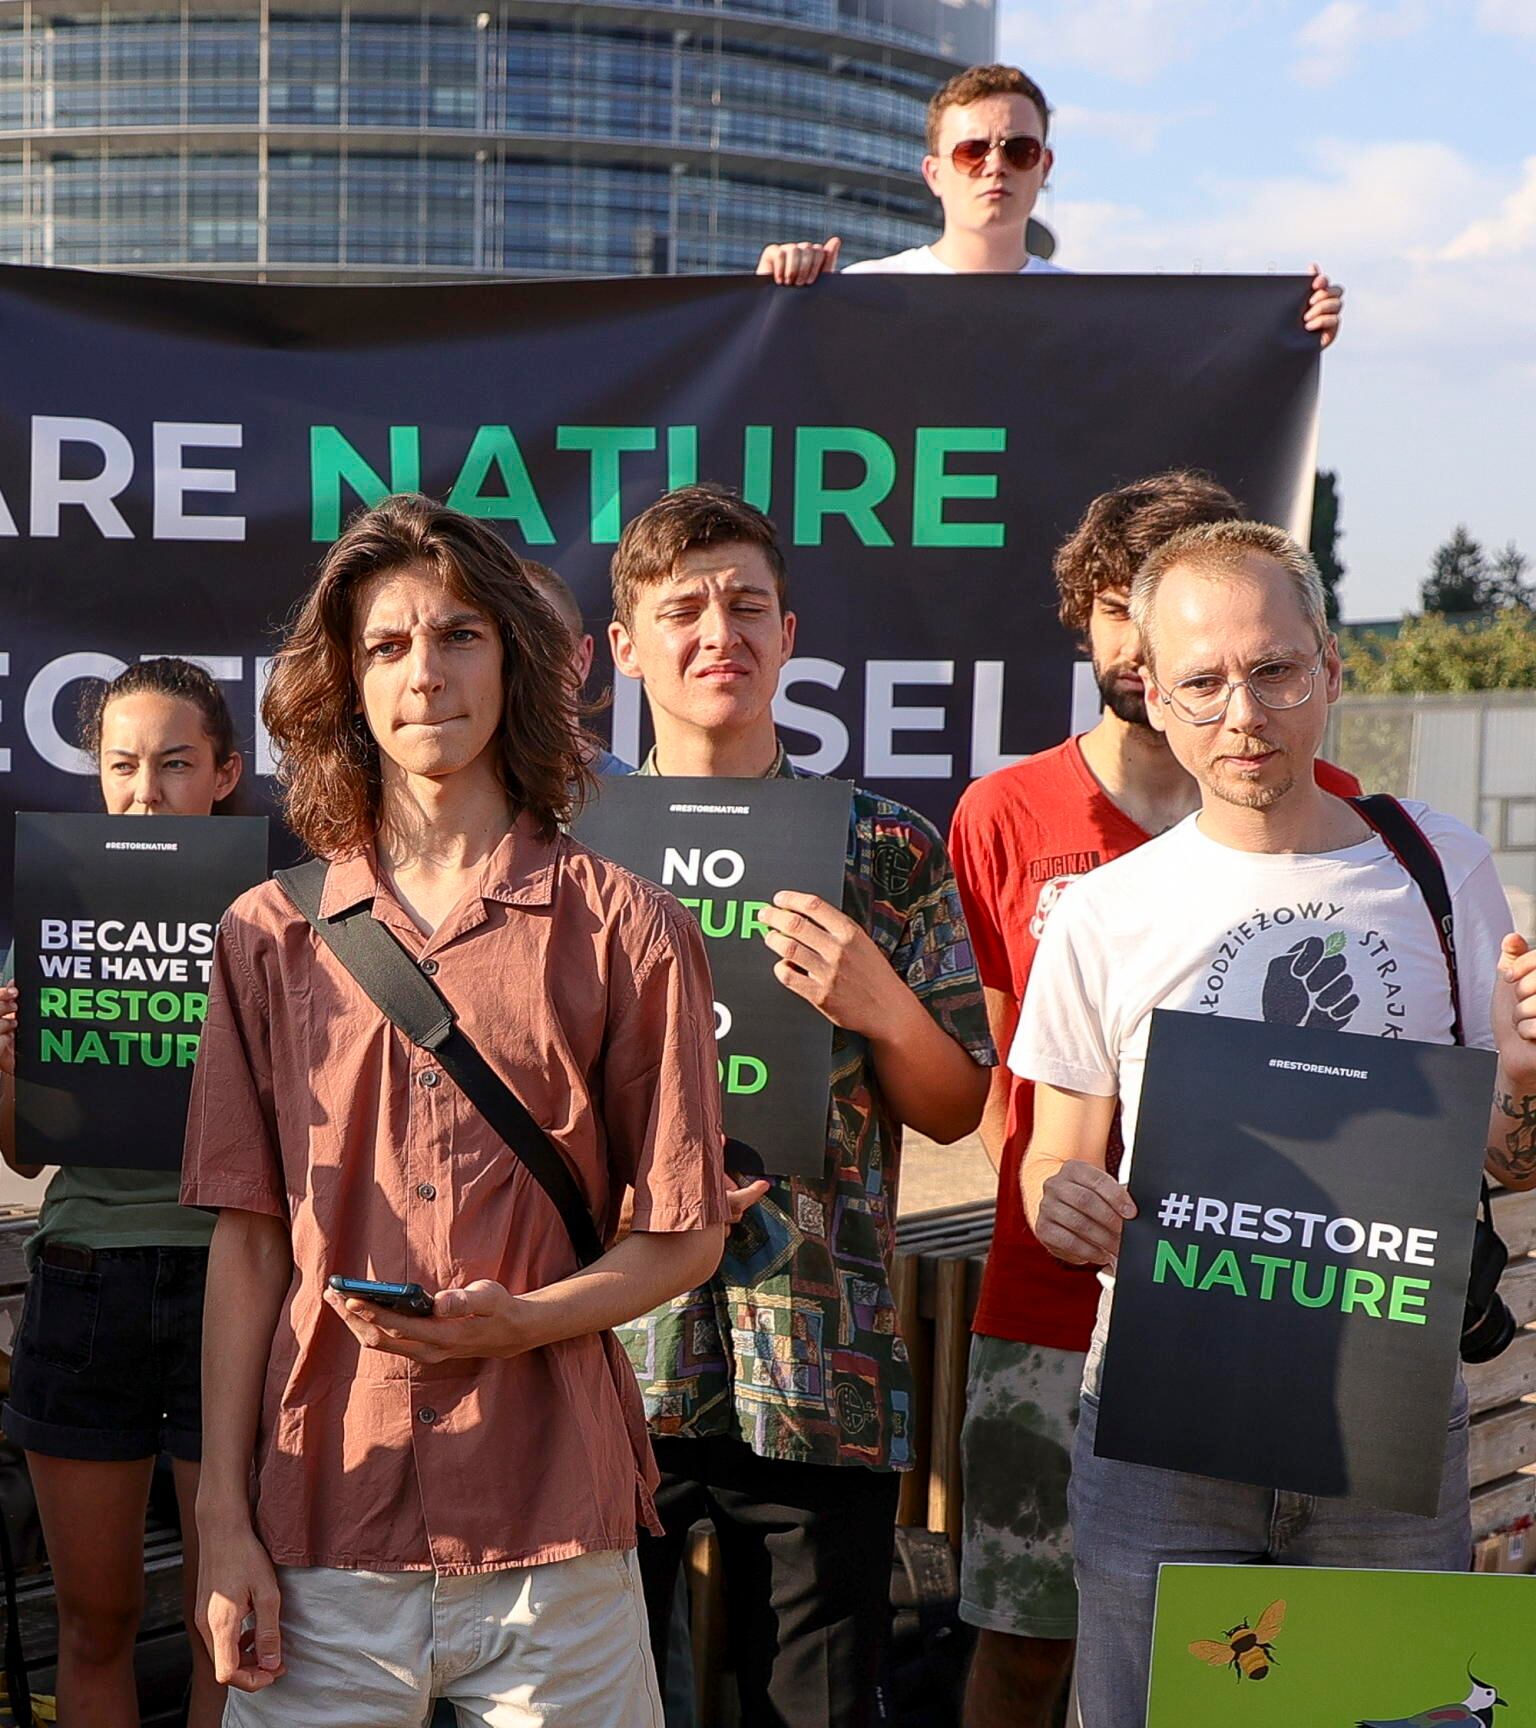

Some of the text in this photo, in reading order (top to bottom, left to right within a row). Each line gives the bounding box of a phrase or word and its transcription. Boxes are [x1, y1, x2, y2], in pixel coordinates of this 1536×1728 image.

[309, 424, 1007, 548] NATURE
[669, 803, 750, 815] #RESTORENATURE
[105, 841, 178, 851] #RESTORENATURE
[662, 847, 746, 888] NO
[40, 918, 221, 955] BECAUS
[39, 955, 92, 979] WE
[101, 956, 187, 982] HAVE
[1358, 929, 1406, 1040] STRAJK
[1268, 1058, 1369, 1080] #RESTORENATURE
[1158, 1192, 1439, 1267] #RESTORE
[1152, 1239, 1432, 1326] NATURE
